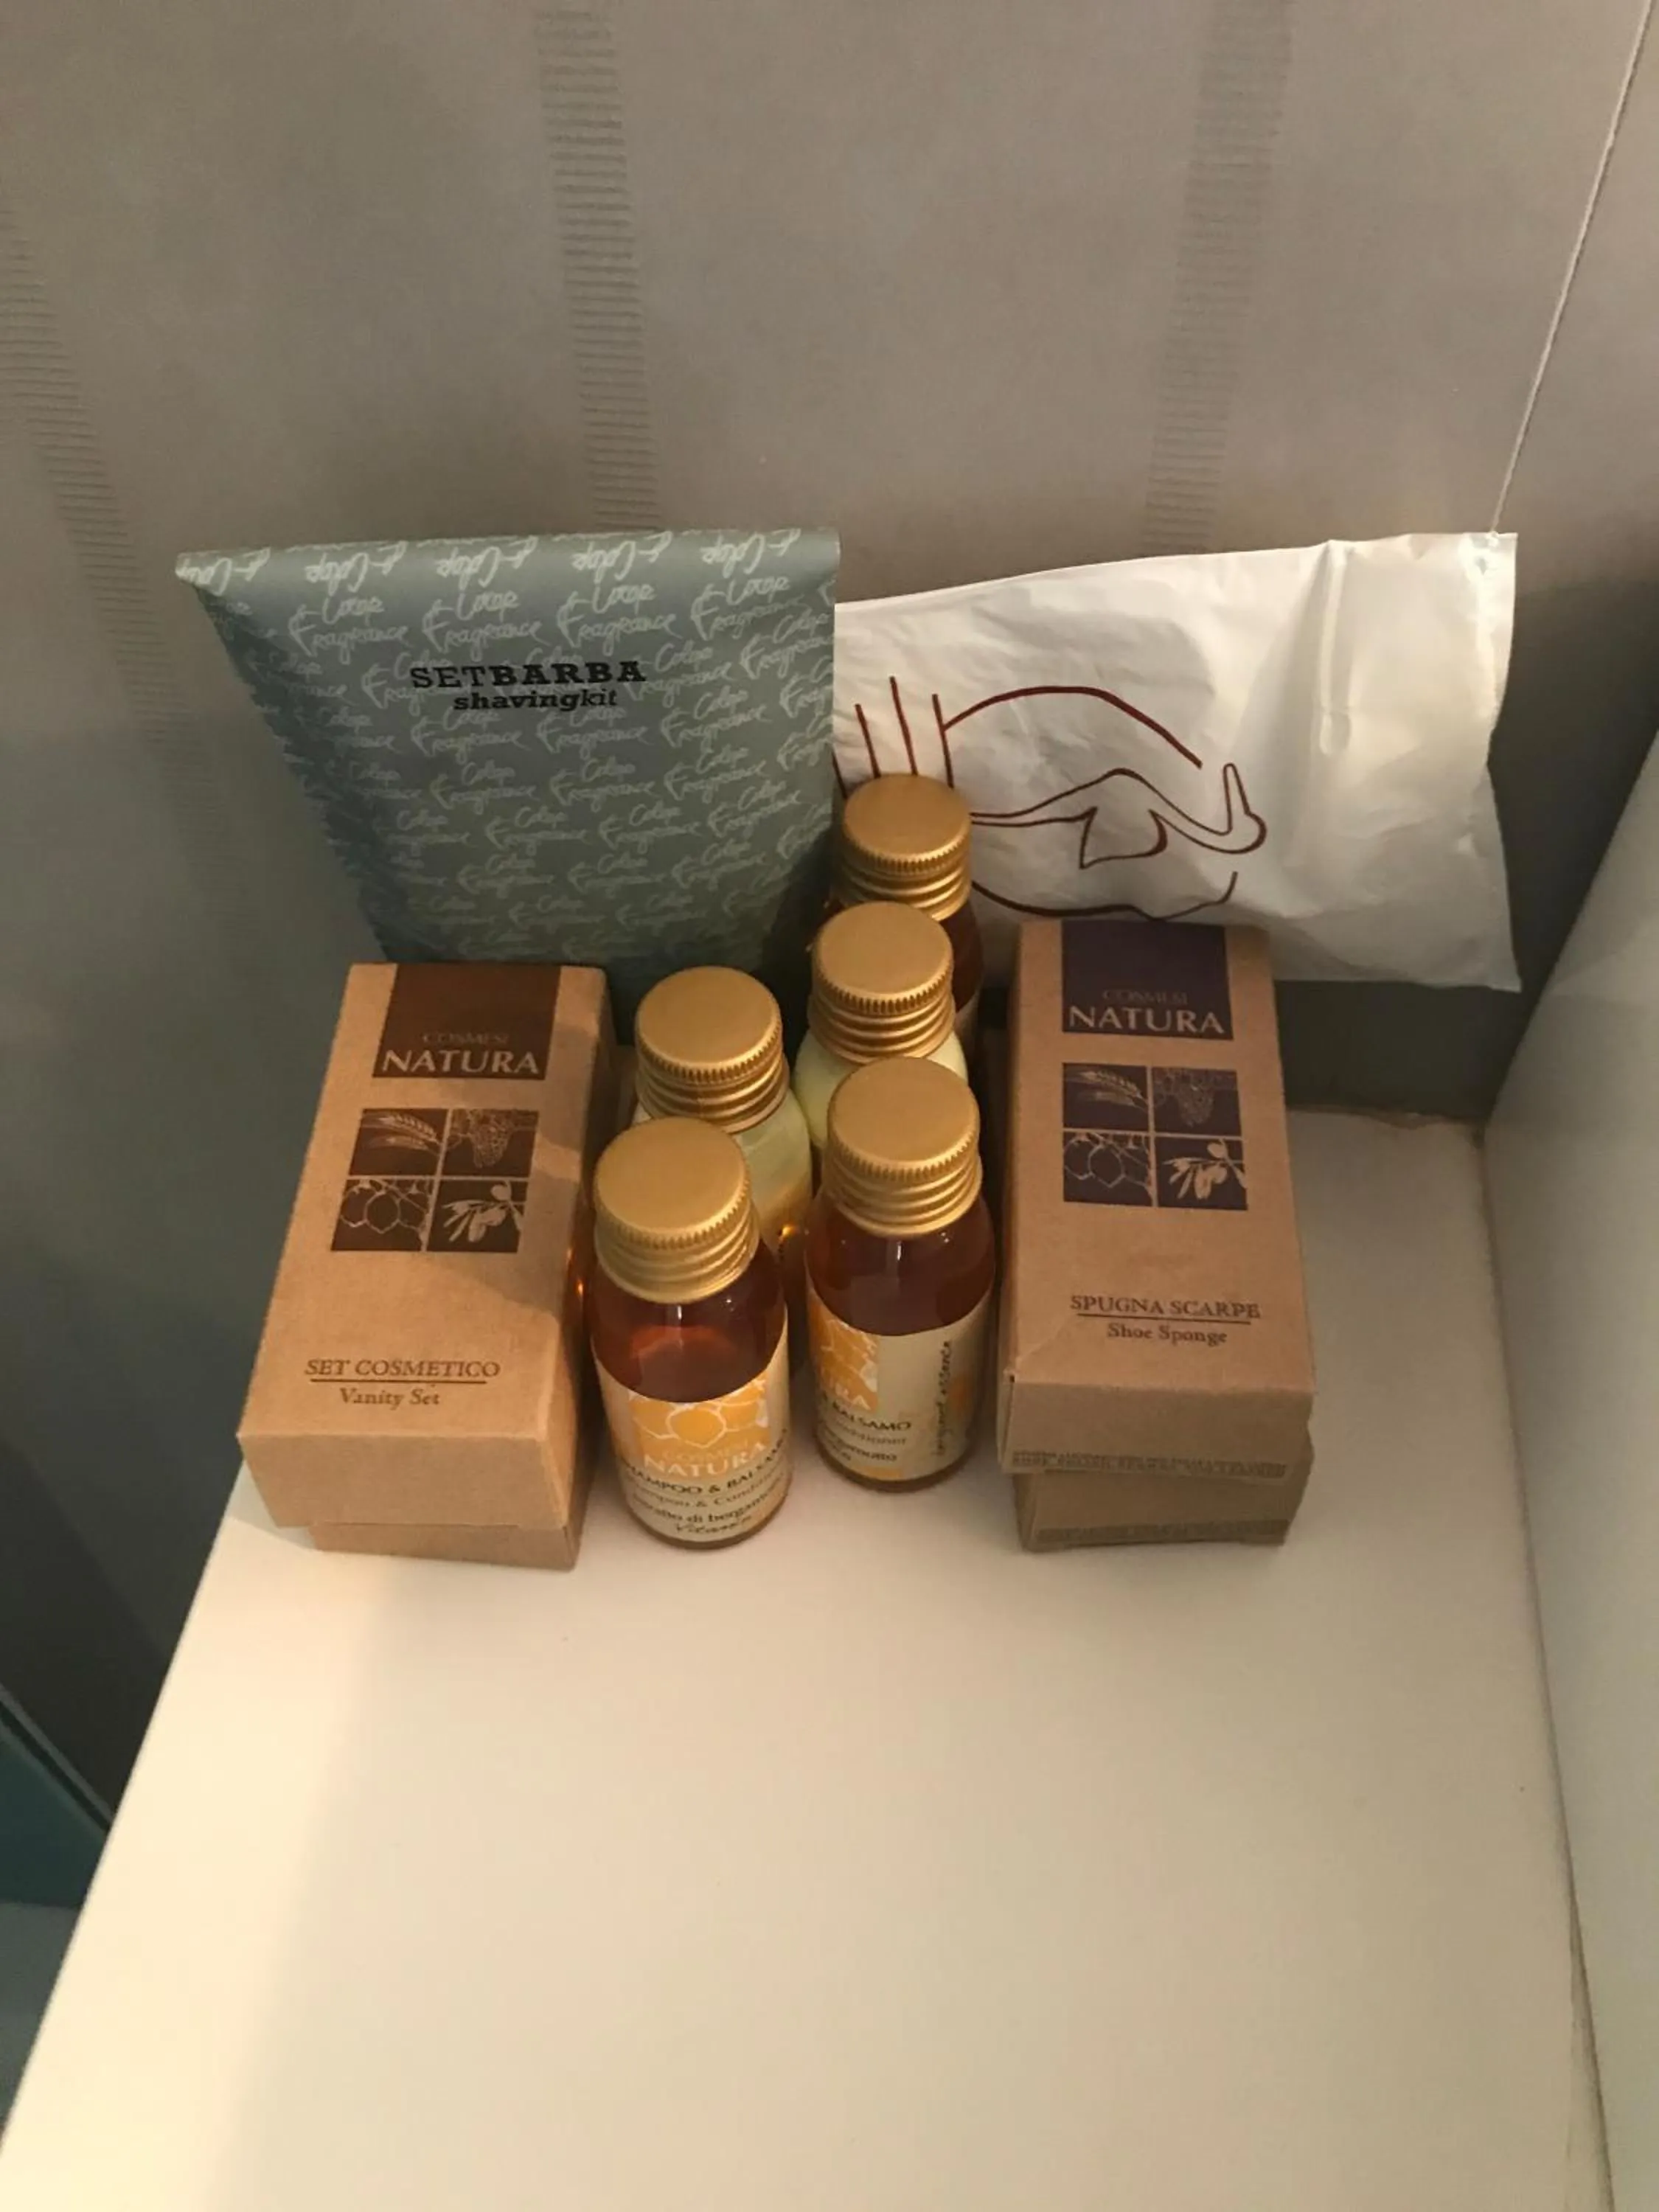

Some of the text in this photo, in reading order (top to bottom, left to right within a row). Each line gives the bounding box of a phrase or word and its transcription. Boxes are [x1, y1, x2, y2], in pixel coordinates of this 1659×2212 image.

[409, 661, 647, 688] SETBARBA
[453, 689, 618, 712] shavingkit
[1069, 1006, 1225, 1034] NATURA
[382, 1049, 540, 1074] NATURA
[1070, 1295, 1261, 1319] SPUGNA SCARPE
[1107, 1323, 1228, 1347] Shoe Sponge
[304, 1359, 501, 1377] SET COSMETICO
[340, 1388, 440, 1411] Vanity Set
[644, 1441, 767, 1477] NATURA
[624, 1459, 703, 1493] HAMPOO
